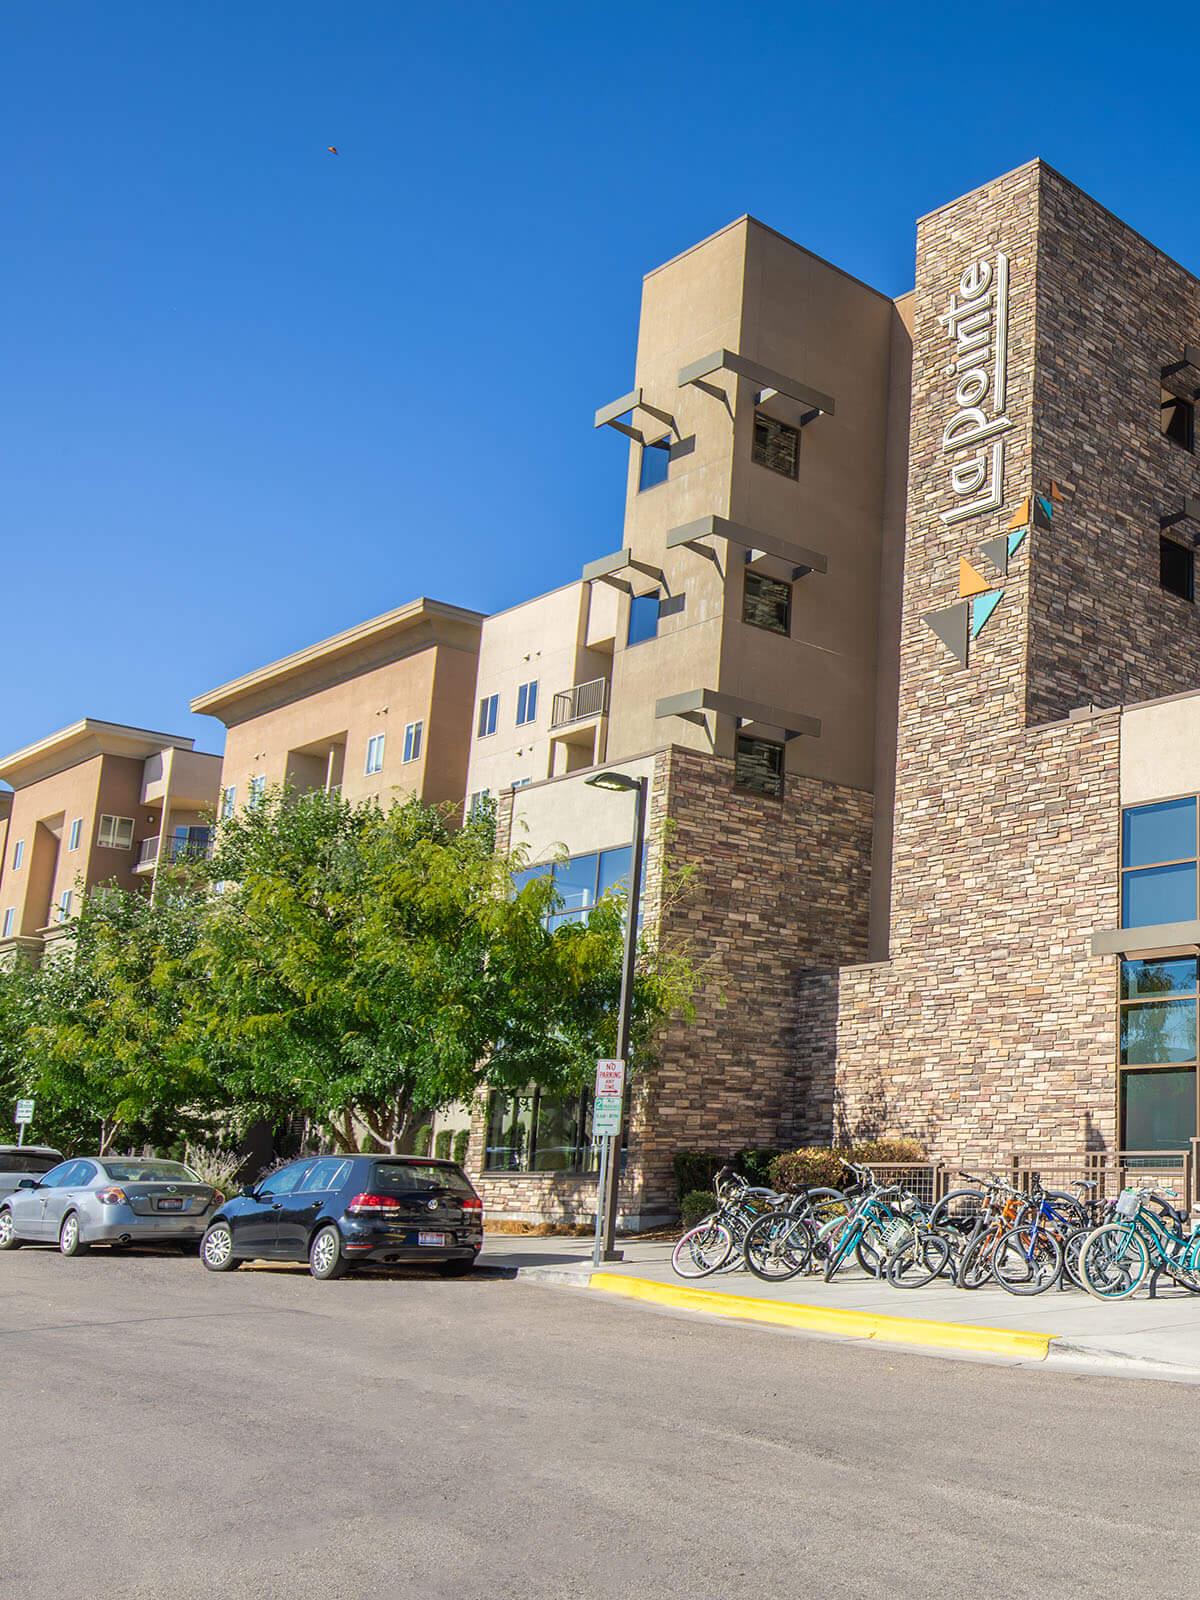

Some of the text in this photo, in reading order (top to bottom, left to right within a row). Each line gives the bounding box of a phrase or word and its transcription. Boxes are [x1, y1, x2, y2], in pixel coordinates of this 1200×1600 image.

[938, 251, 1016, 525] La Pointe
[605, 1062, 617, 1072] NO
[599, 1071, 622, 1079] PARKING
